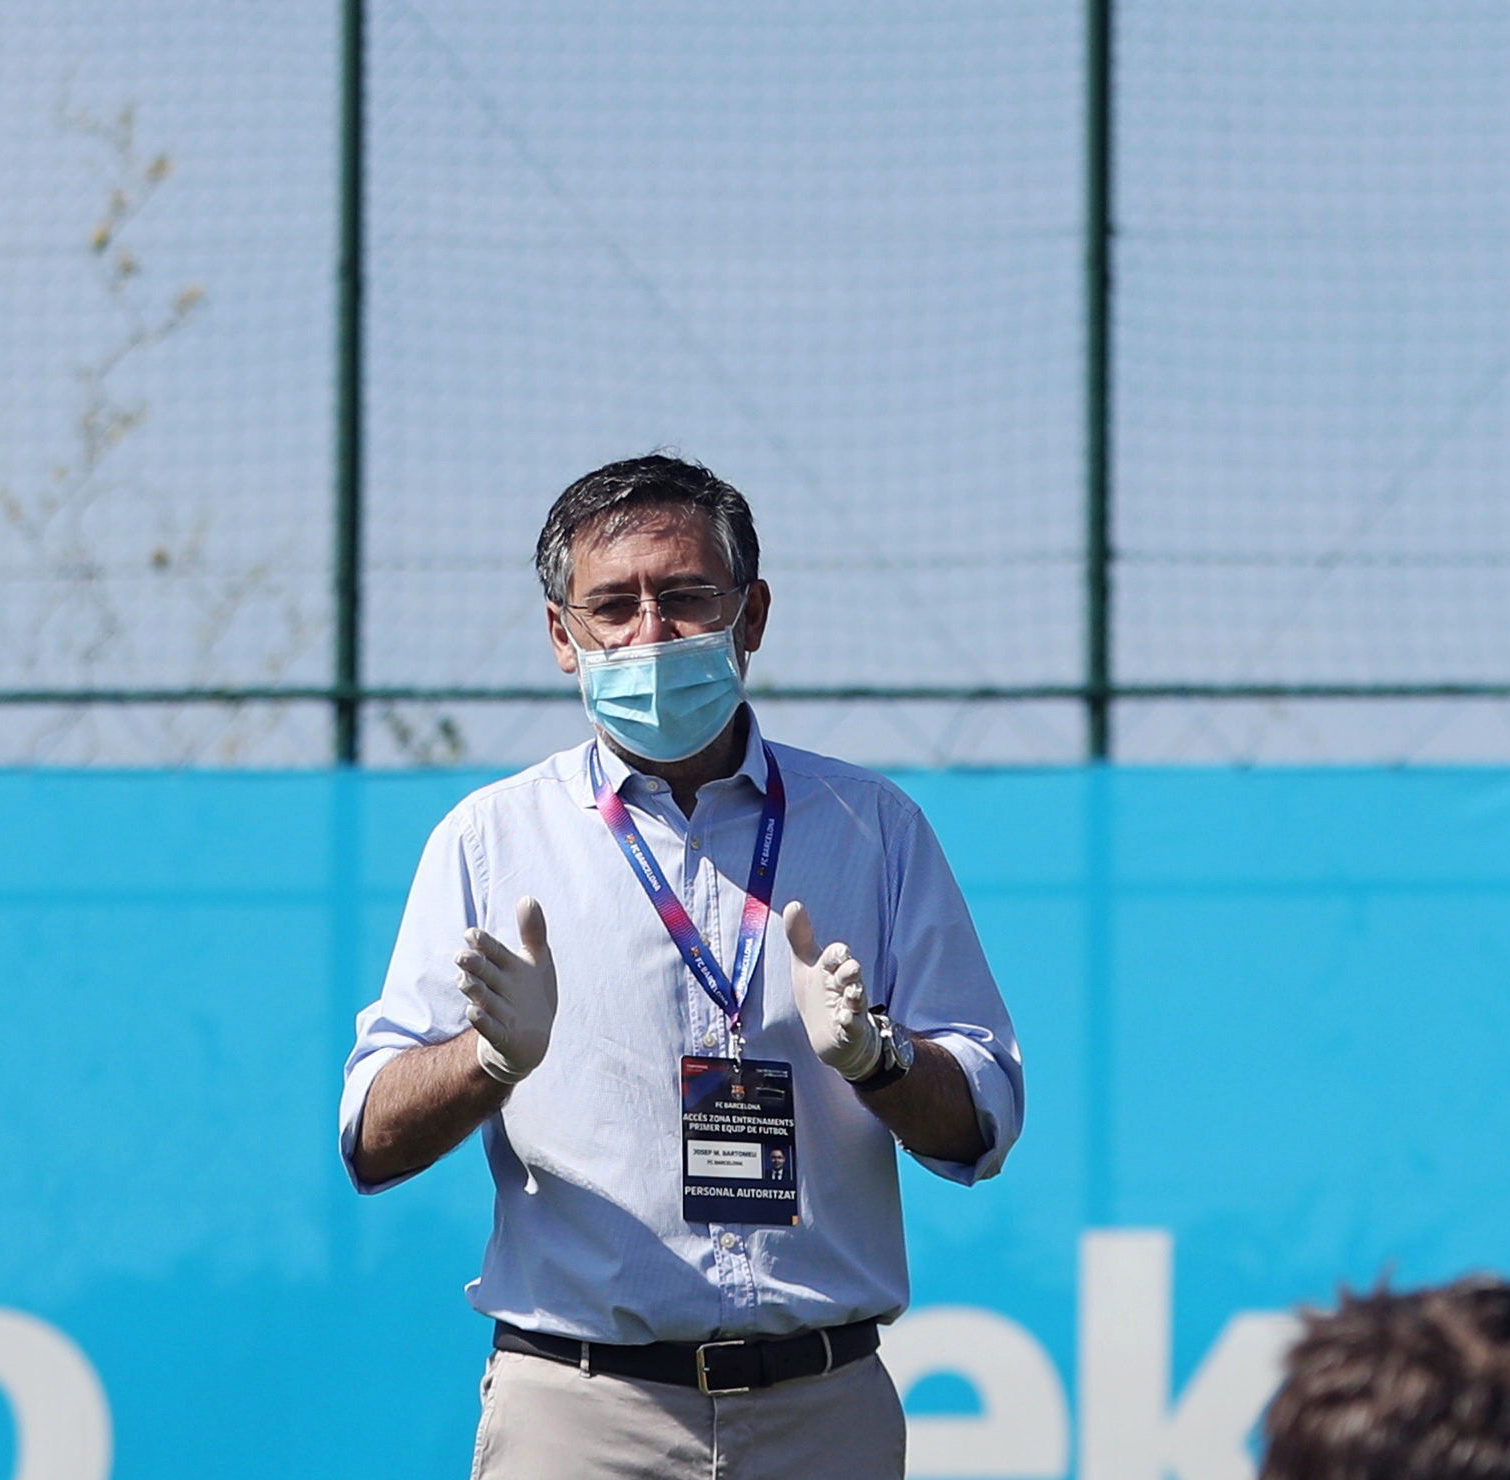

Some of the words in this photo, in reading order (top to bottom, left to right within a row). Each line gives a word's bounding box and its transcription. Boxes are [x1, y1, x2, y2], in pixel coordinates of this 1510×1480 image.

[715, 1101, 723, 1109] FC
[724, 1102, 761, 1111] BARCELONA
[683, 1112, 708, 1122] ACCÉS
[709, 1114, 731, 1123] ZONA
[732, 1115, 794, 1127] ENTRENAMENTS
[689, 1122, 720, 1132] PRIMER
[721, 1124, 746, 1134] EQUIP
[747, 1125, 757, 1134] DE
[759, 1126, 789, 1136] FUTBOL
[684, 1186, 735, 1197] PERSONAL
[736, 1188, 796, 1200] AUTORITZAT
